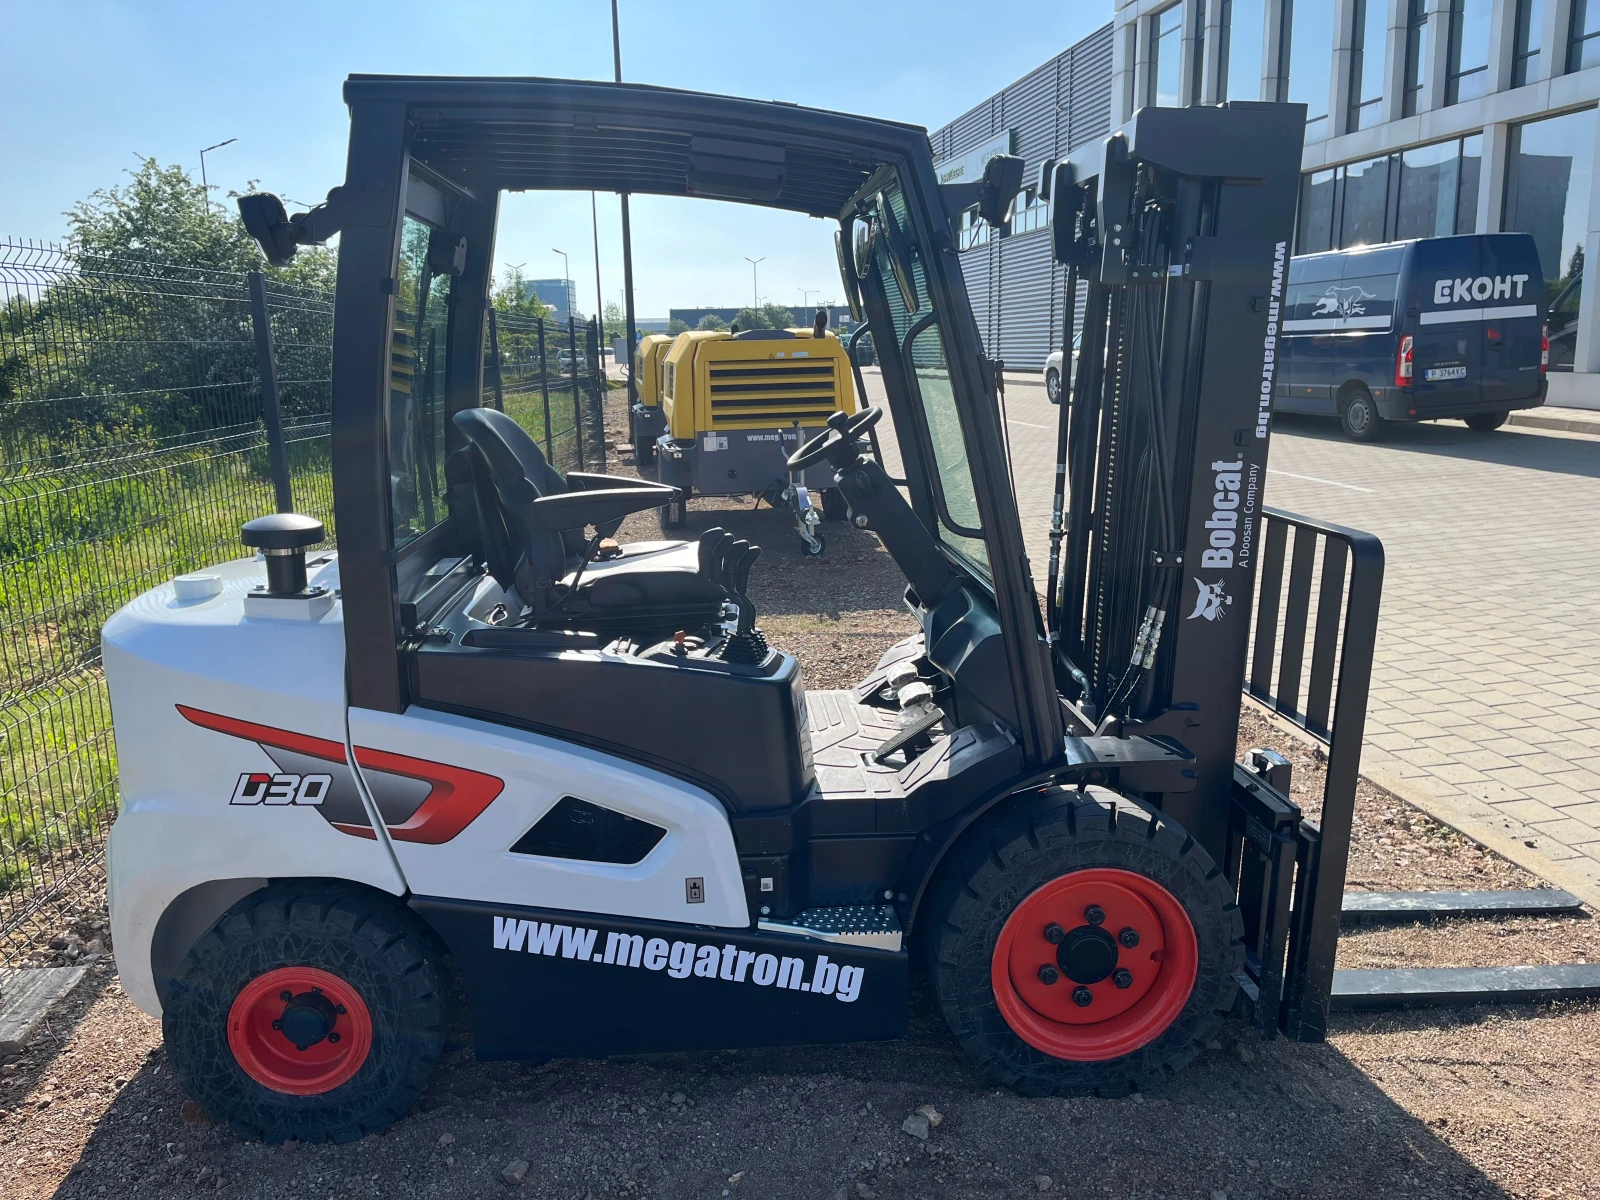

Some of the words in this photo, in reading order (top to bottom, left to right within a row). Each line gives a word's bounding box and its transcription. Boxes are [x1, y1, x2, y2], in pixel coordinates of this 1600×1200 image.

[1255, 241, 1286, 439] www.megatron.bg
[1243, 463, 1260, 514] Company
[1239, 517, 1252, 557] Doosan
[1239, 559, 1248, 568] A
[229, 773, 334, 806] D30
[493, 915, 865, 1003] www.megatron.bg
